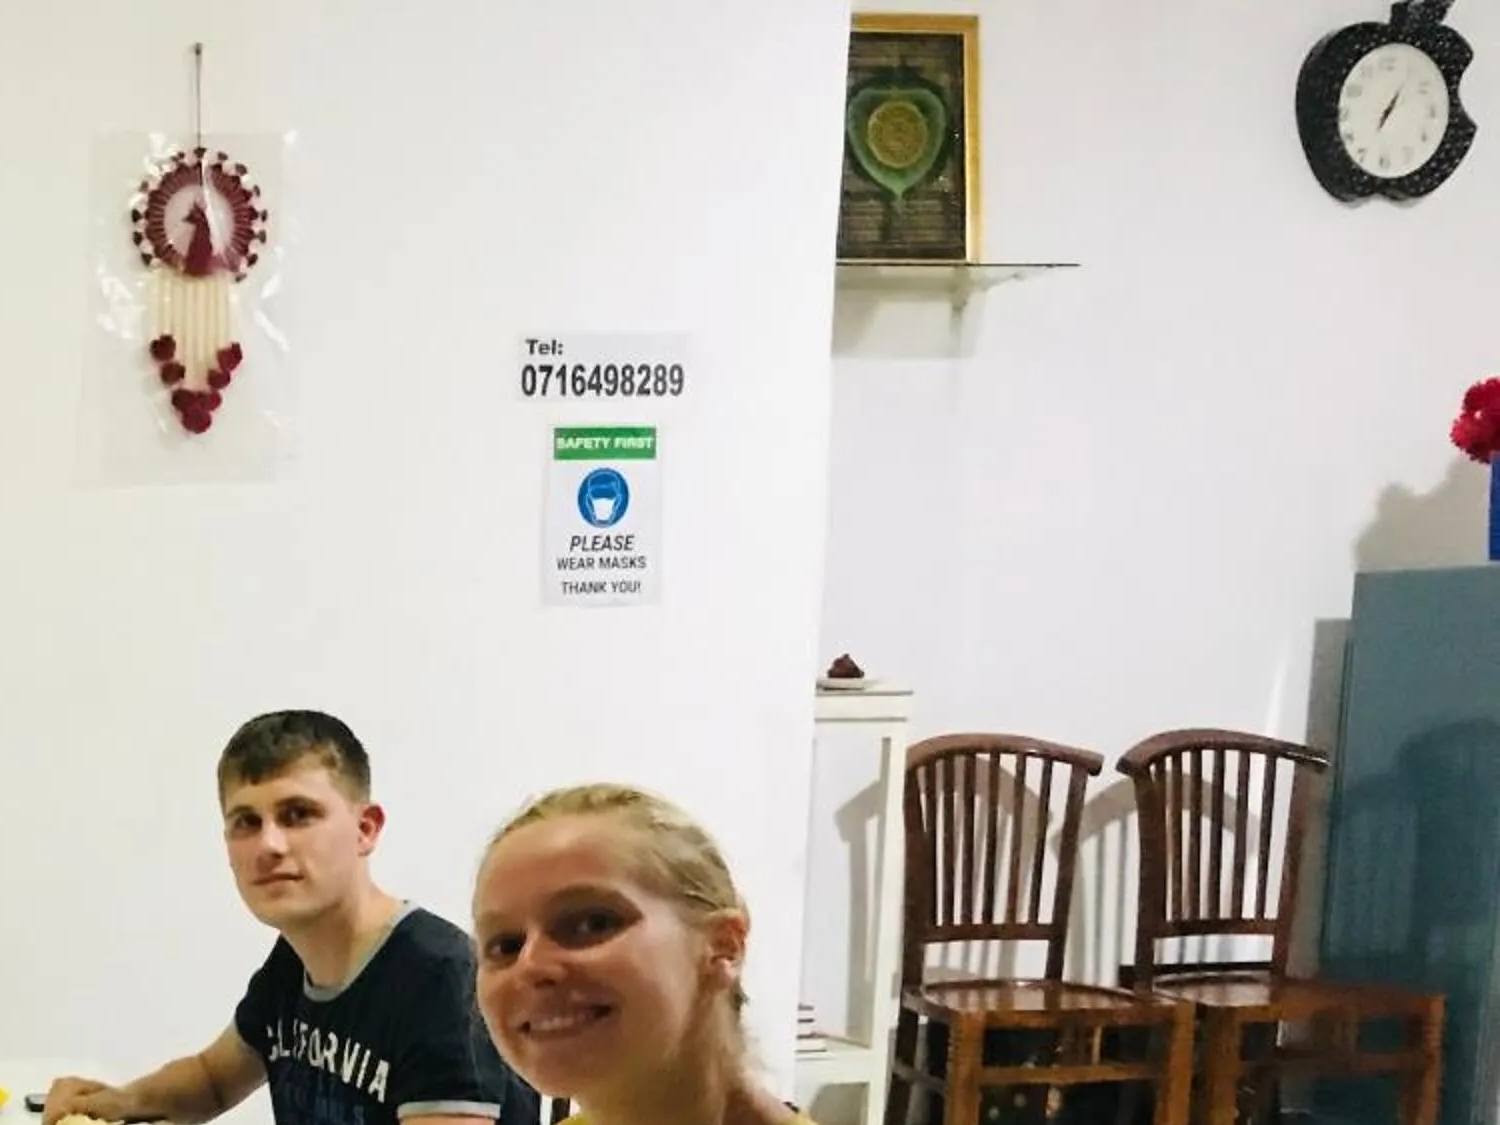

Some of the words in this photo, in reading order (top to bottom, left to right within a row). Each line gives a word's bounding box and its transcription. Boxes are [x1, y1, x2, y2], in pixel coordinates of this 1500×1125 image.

[525, 338, 564, 356] Tel:
[520, 363, 685, 397] 0716498289
[556, 436, 611, 449] SAFETY
[613, 436, 653, 449] FIRST
[569, 534, 635, 552] PLEASE
[556, 556, 595, 570] WEAR
[599, 555, 647, 569] MASKS
[561, 580, 607, 594] THANK
